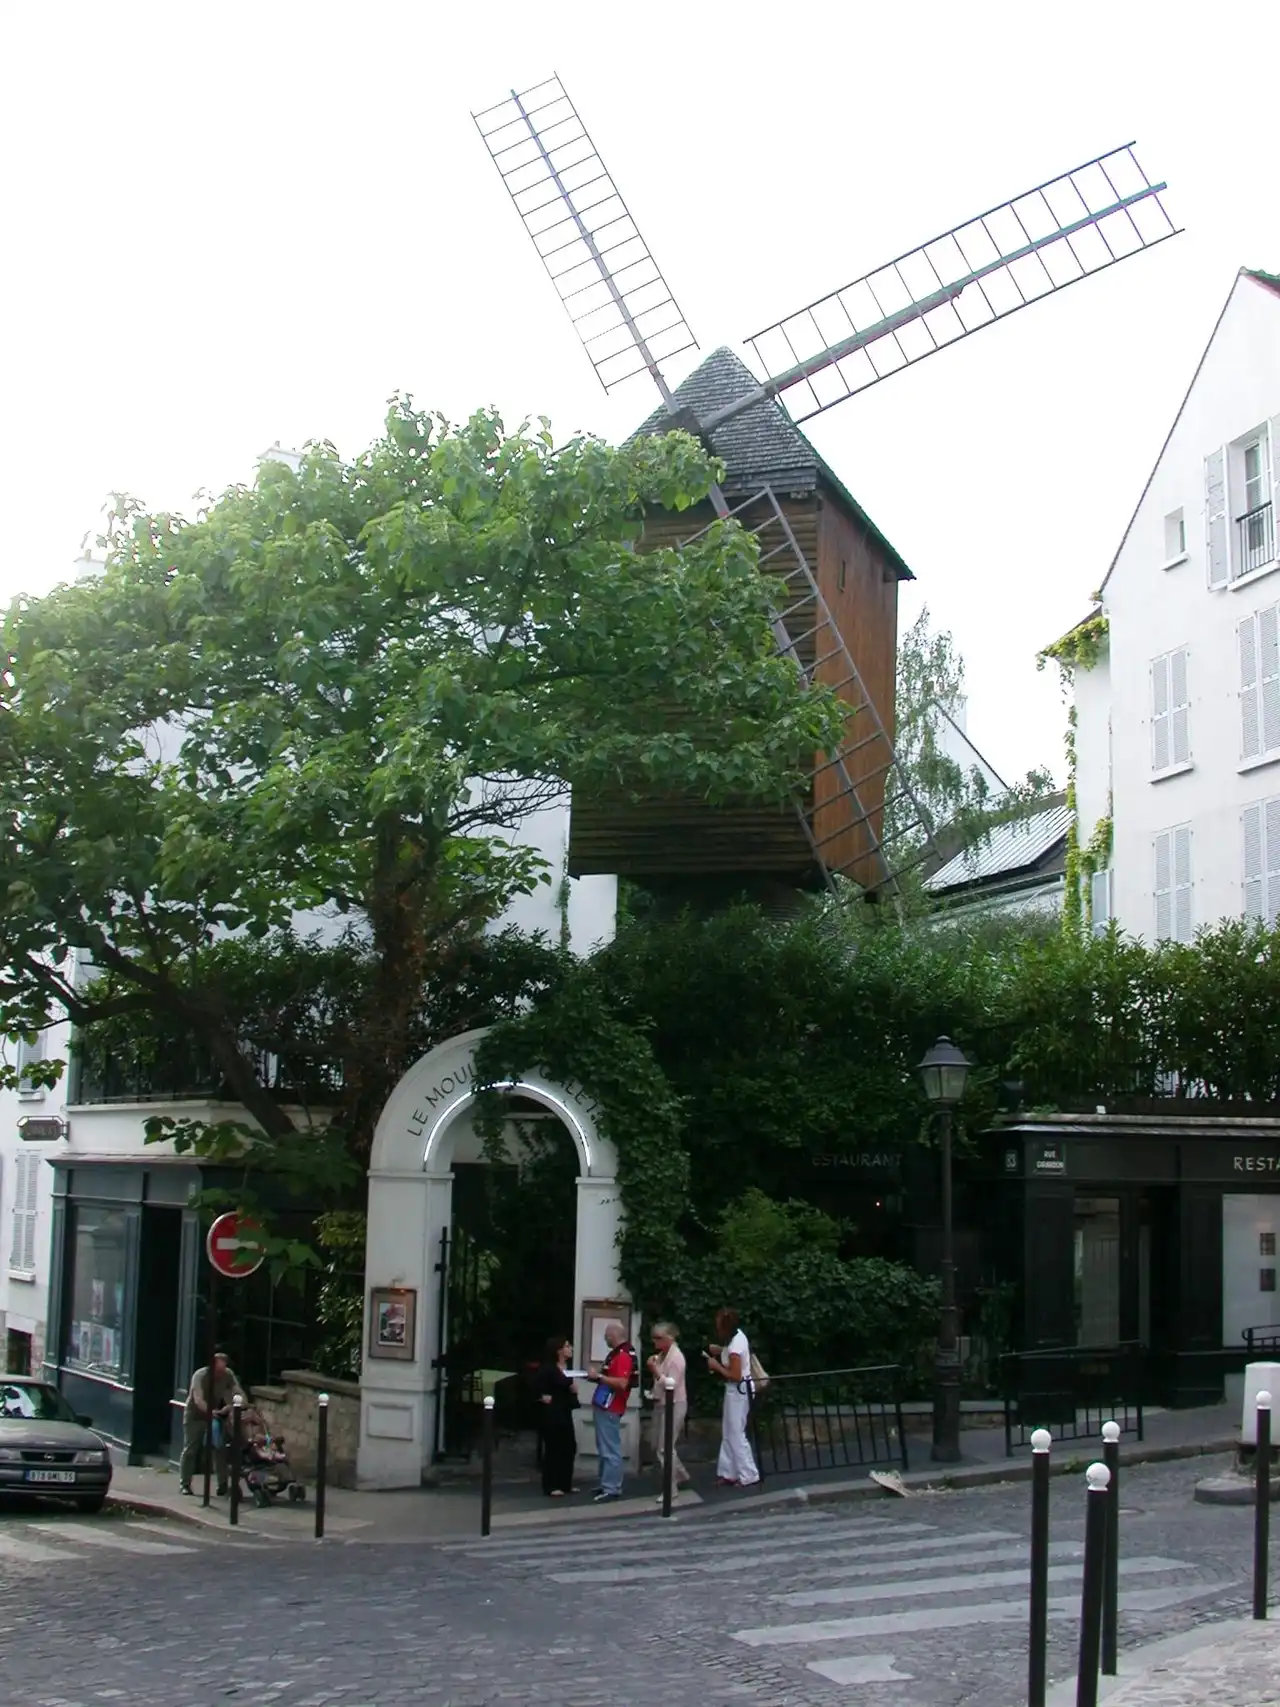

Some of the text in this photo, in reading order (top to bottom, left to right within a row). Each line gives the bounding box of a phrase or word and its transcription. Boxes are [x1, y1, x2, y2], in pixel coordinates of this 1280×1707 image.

[407, 1109, 428, 1137] LE
[425, 1063, 478, 1108] MOUL
[812, 1153, 904, 1168] ESTAURANT
[1044, 1150, 1056, 1158] RUE
